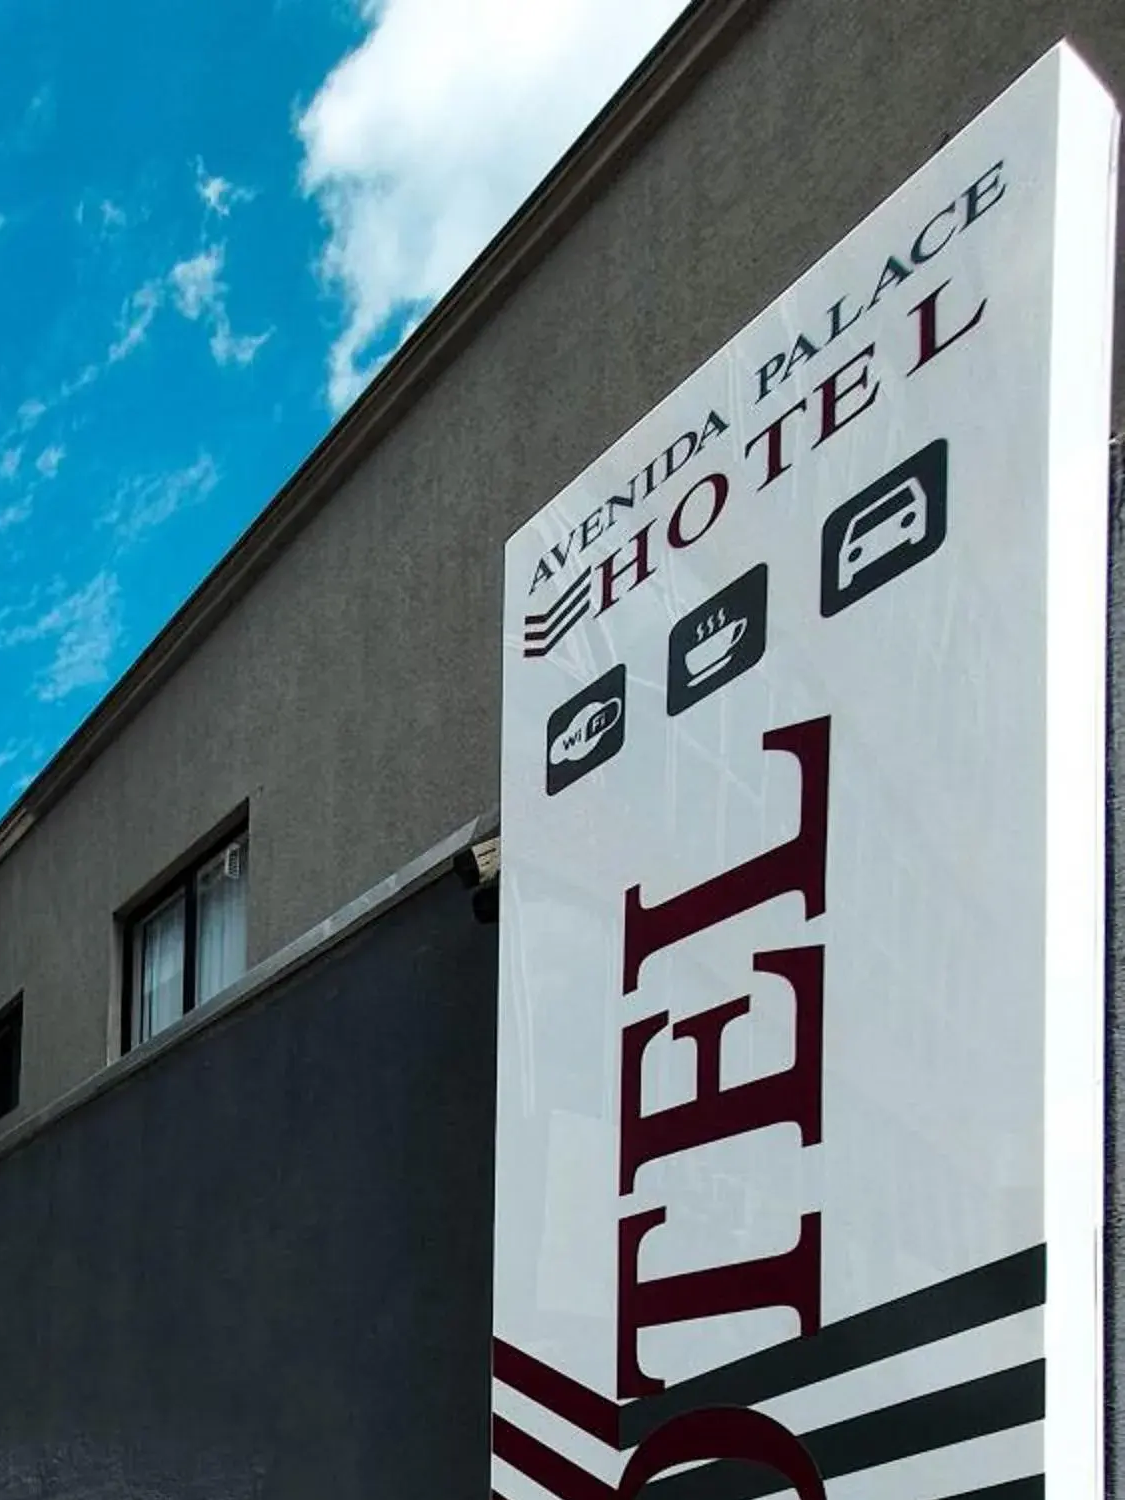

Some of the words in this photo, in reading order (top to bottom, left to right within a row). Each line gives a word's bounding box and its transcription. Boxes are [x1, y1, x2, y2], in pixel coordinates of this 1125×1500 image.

[528, 409, 731, 594] AVENIDA
[754, 159, 1008, 402] PALACE
[593, 280, 987, 618] HOTEL
